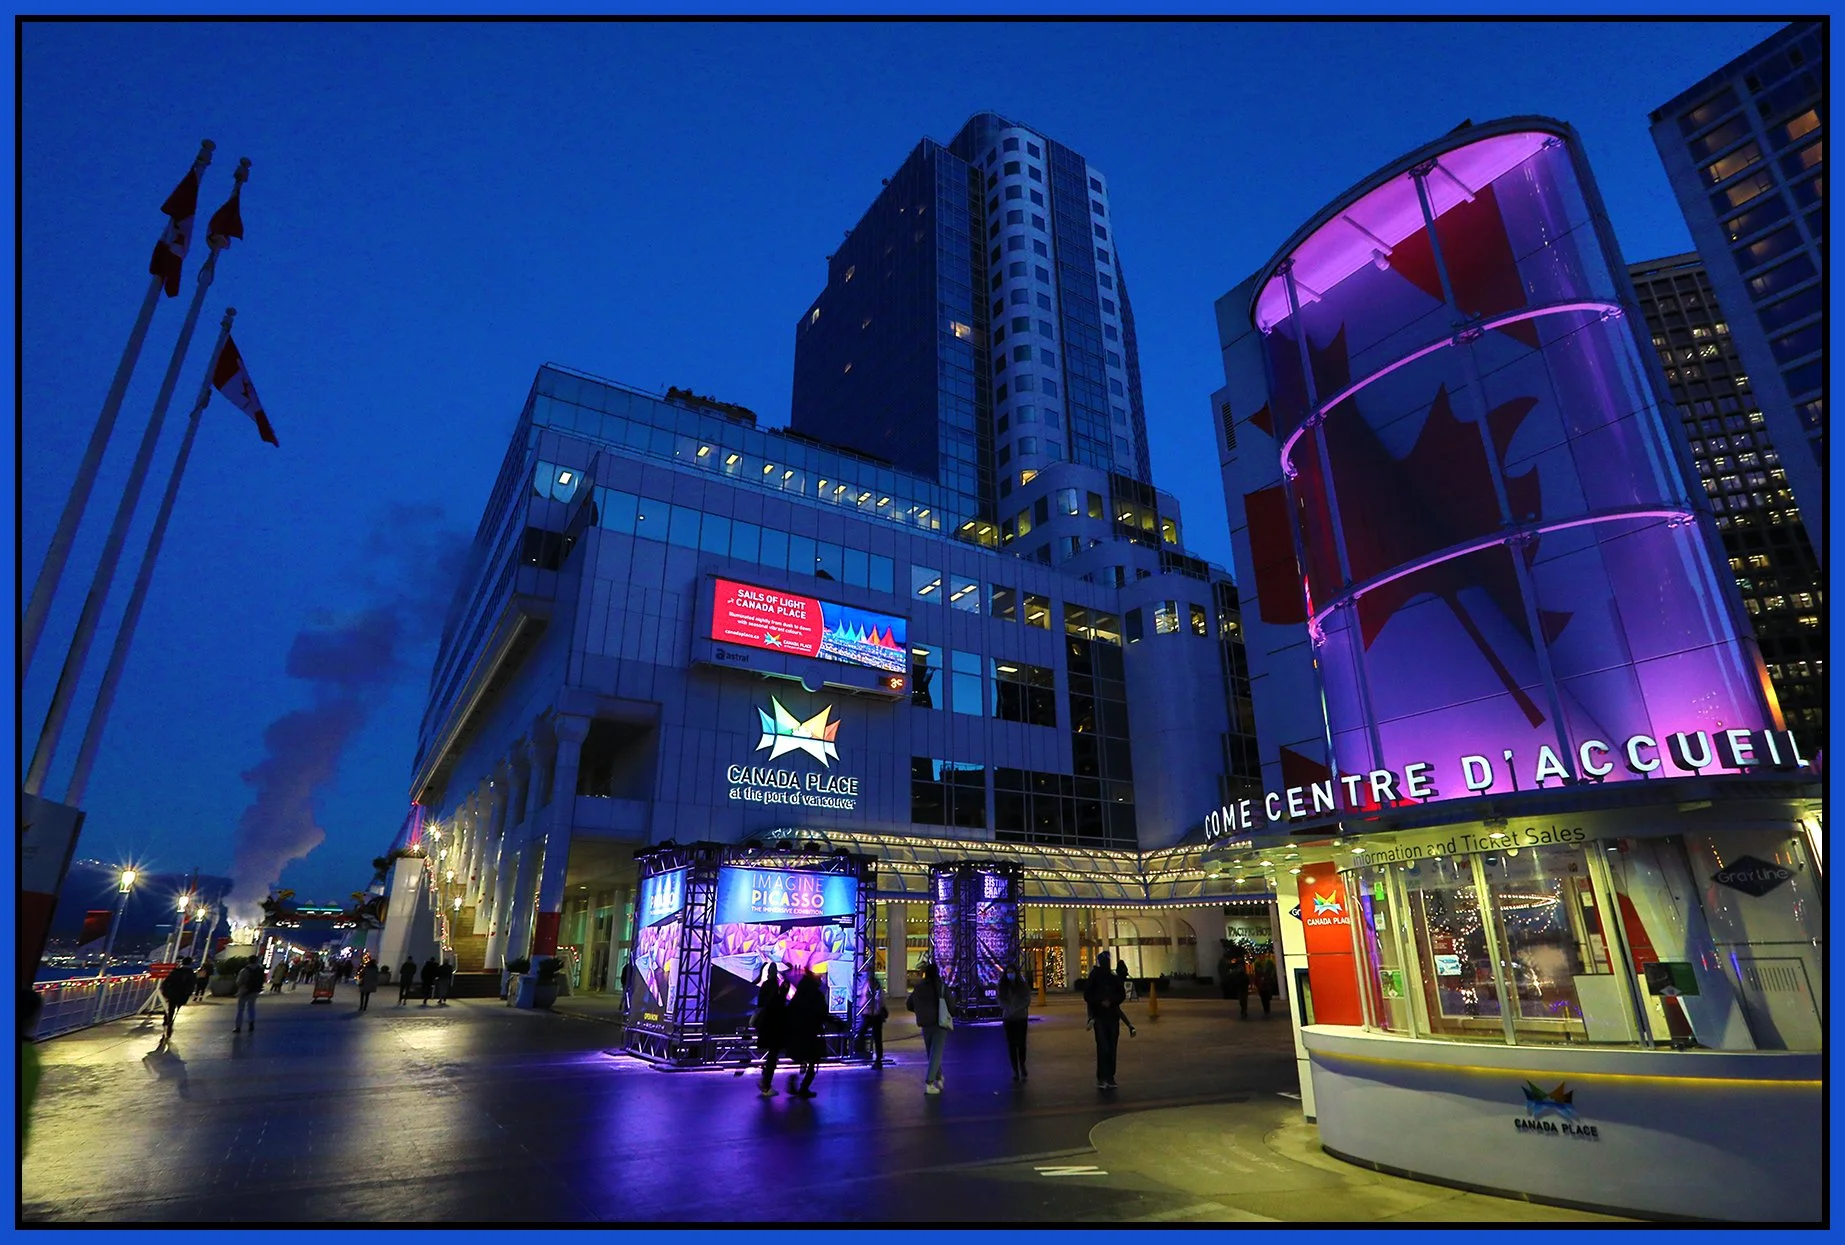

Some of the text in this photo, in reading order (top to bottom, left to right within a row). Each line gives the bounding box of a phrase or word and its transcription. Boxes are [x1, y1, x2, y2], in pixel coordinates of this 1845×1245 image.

[736, 598, 806, 619] CANADA PLACE
[738, 589, 806, 610] SAILS OF LIGHT
[726, 653, 749, 663] astral
[727, 764, 859, 796] CANADA PLACE
[729, 787, 857, 810] at the port of vancouver
[1265, 762, 1434, 821] CENTRE
[1427, 837, 1457, 856] and
[1462, 831, 1519, 851] Ticket
[1519, 826, 1586, 845] Sales
[753, 873, 825, 893] IMAGINE
[752, 890, 825, 908] PICASSO
[1307, 918, 1332, 926] CANADA
[1514, 1118, 1599, 1137] CANADA PLACE
